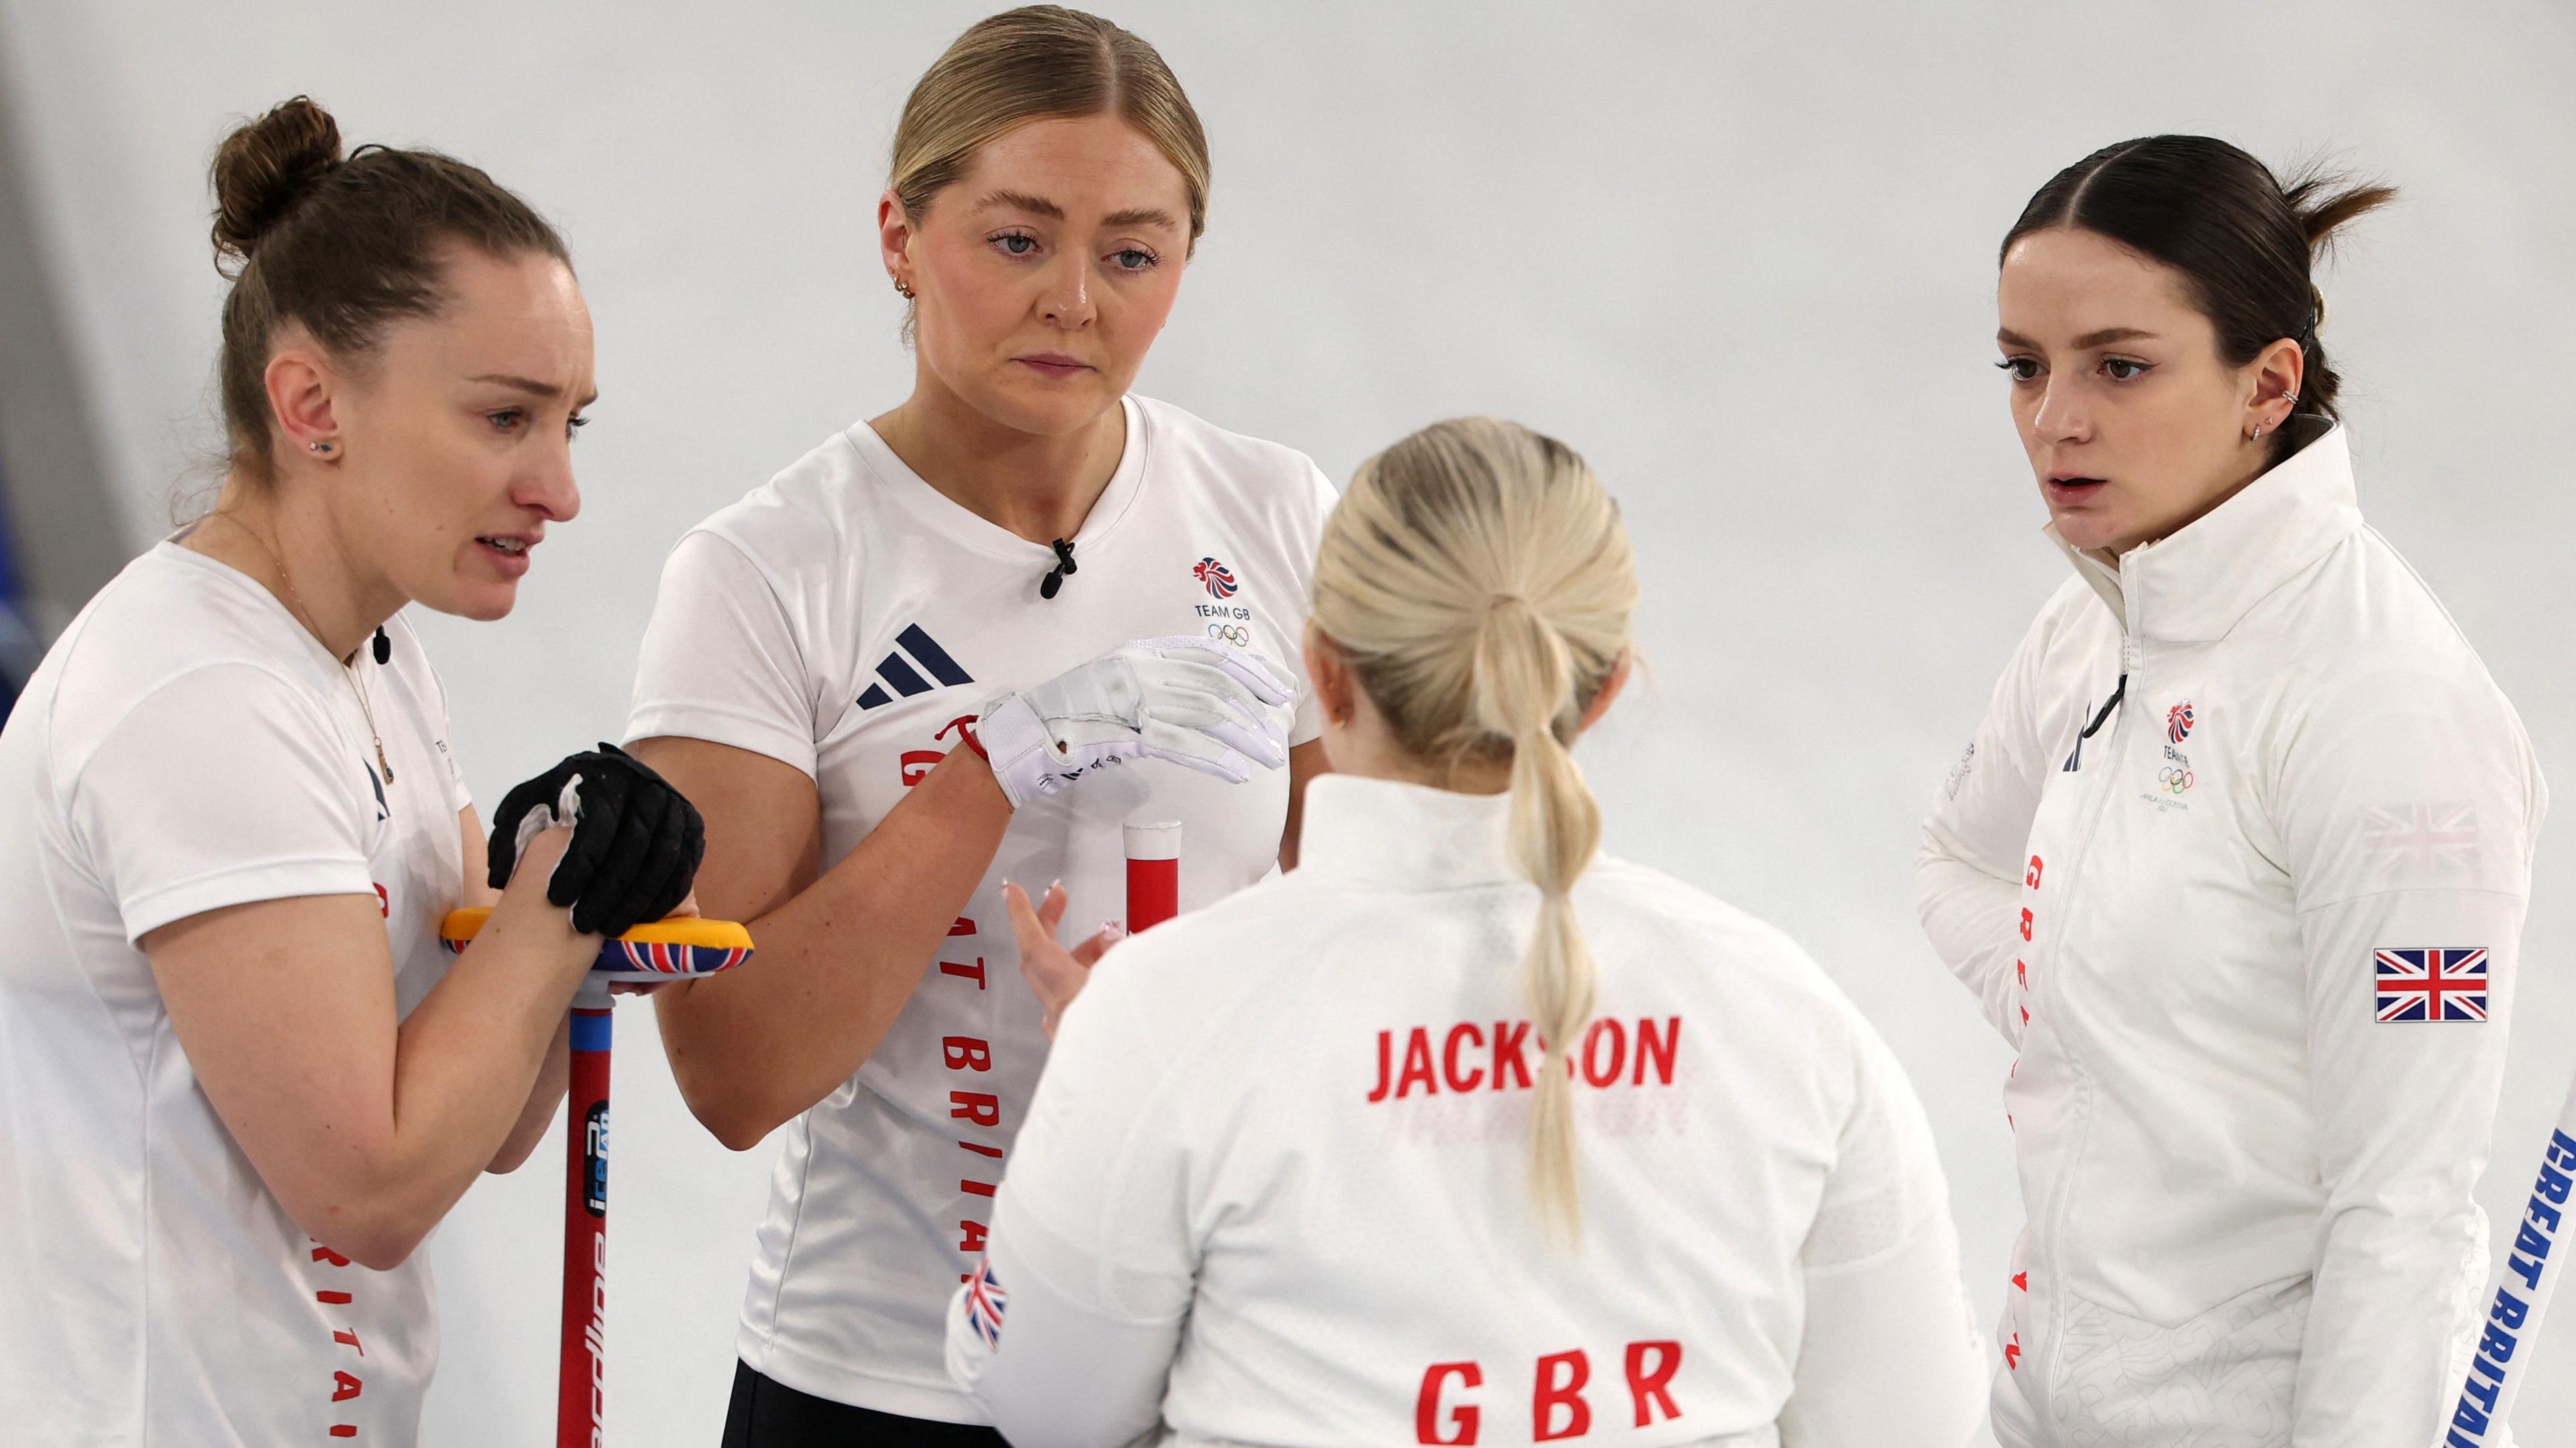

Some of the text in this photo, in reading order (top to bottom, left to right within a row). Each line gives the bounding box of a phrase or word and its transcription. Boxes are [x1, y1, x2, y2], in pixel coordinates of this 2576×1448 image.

[1195, 605, 1250, 620] TEAM GB
[2507, 1127, 2576, 1292] GREAT
[1415, 1339, 1684, 1446] GBR
